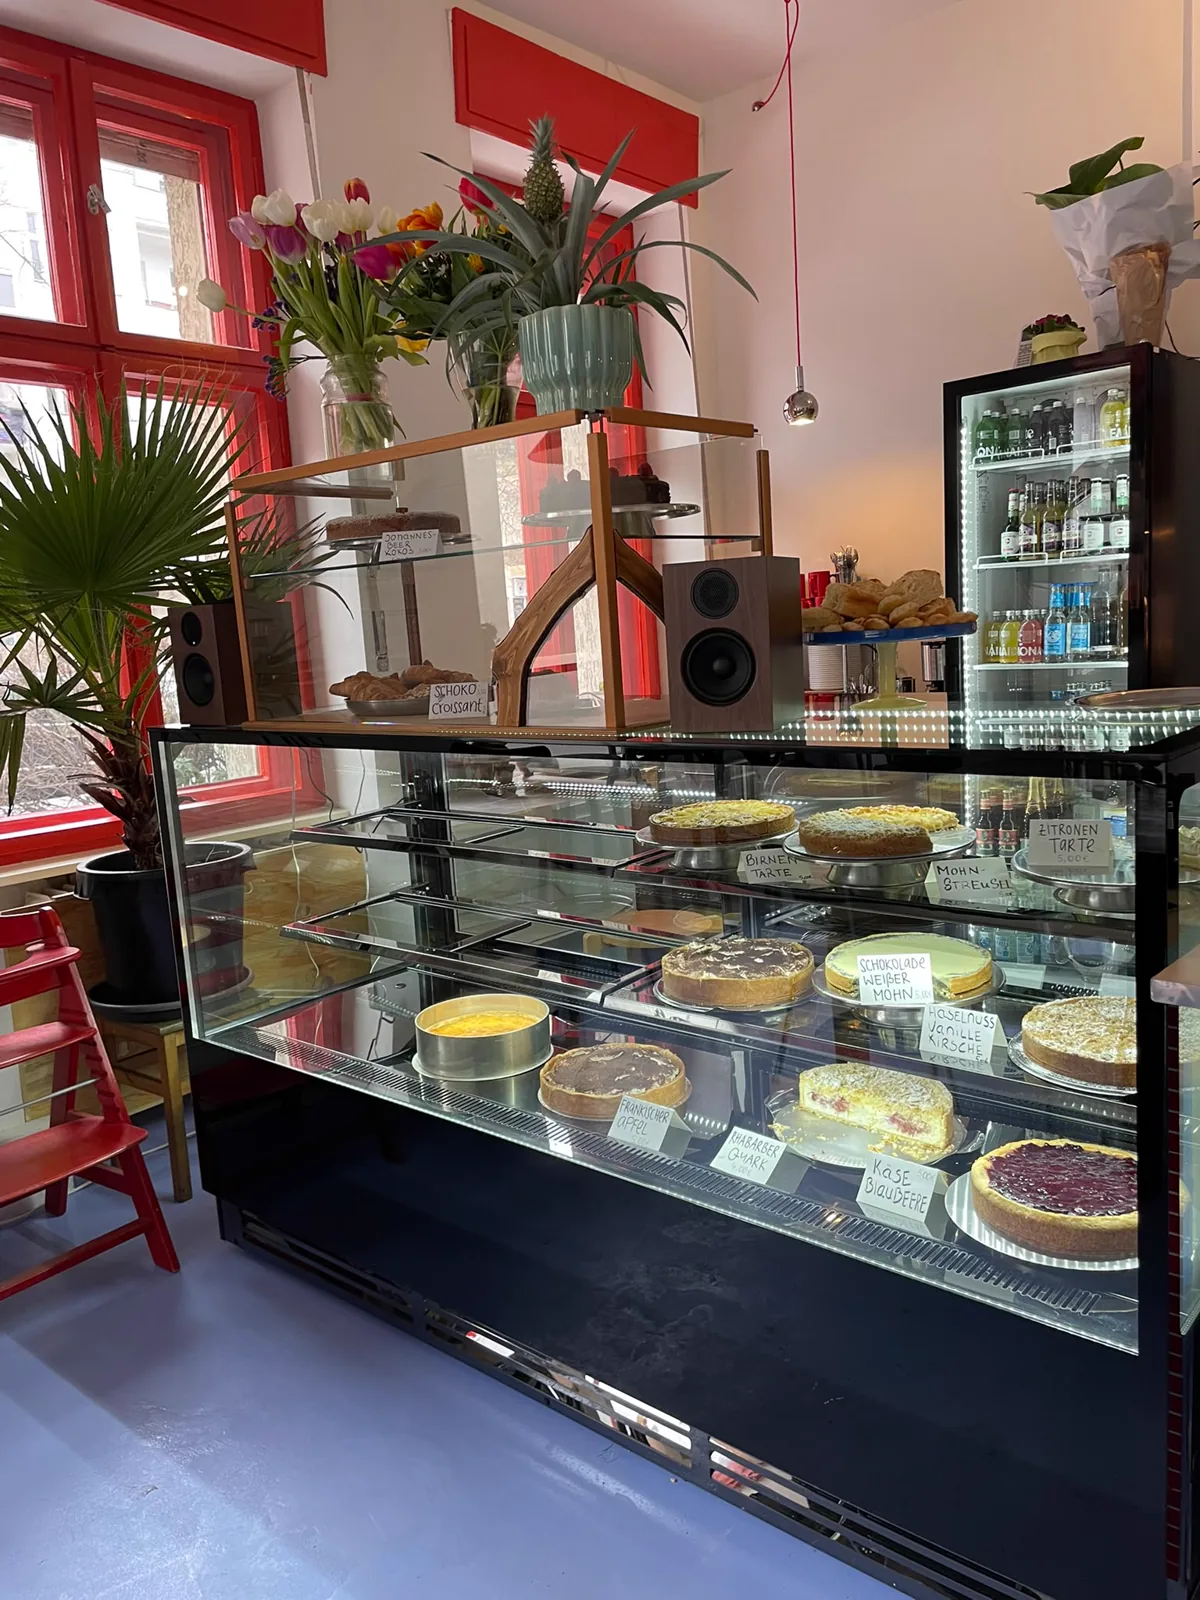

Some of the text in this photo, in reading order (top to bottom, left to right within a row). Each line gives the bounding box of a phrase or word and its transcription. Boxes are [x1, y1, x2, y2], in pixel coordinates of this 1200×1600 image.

[434, 683, 477, 698] SCHOKO
[1038, 823, 1098, 837] ZITRONEN
[745, 853, 798, 866] BIRNEN
[751, 867, 791, 878] TARTE
[936, 865, 986, 876] MOHN-
[873, 986, 913, 1002] MOHN
[728, 1130, 780, 1159] RHABARBER
